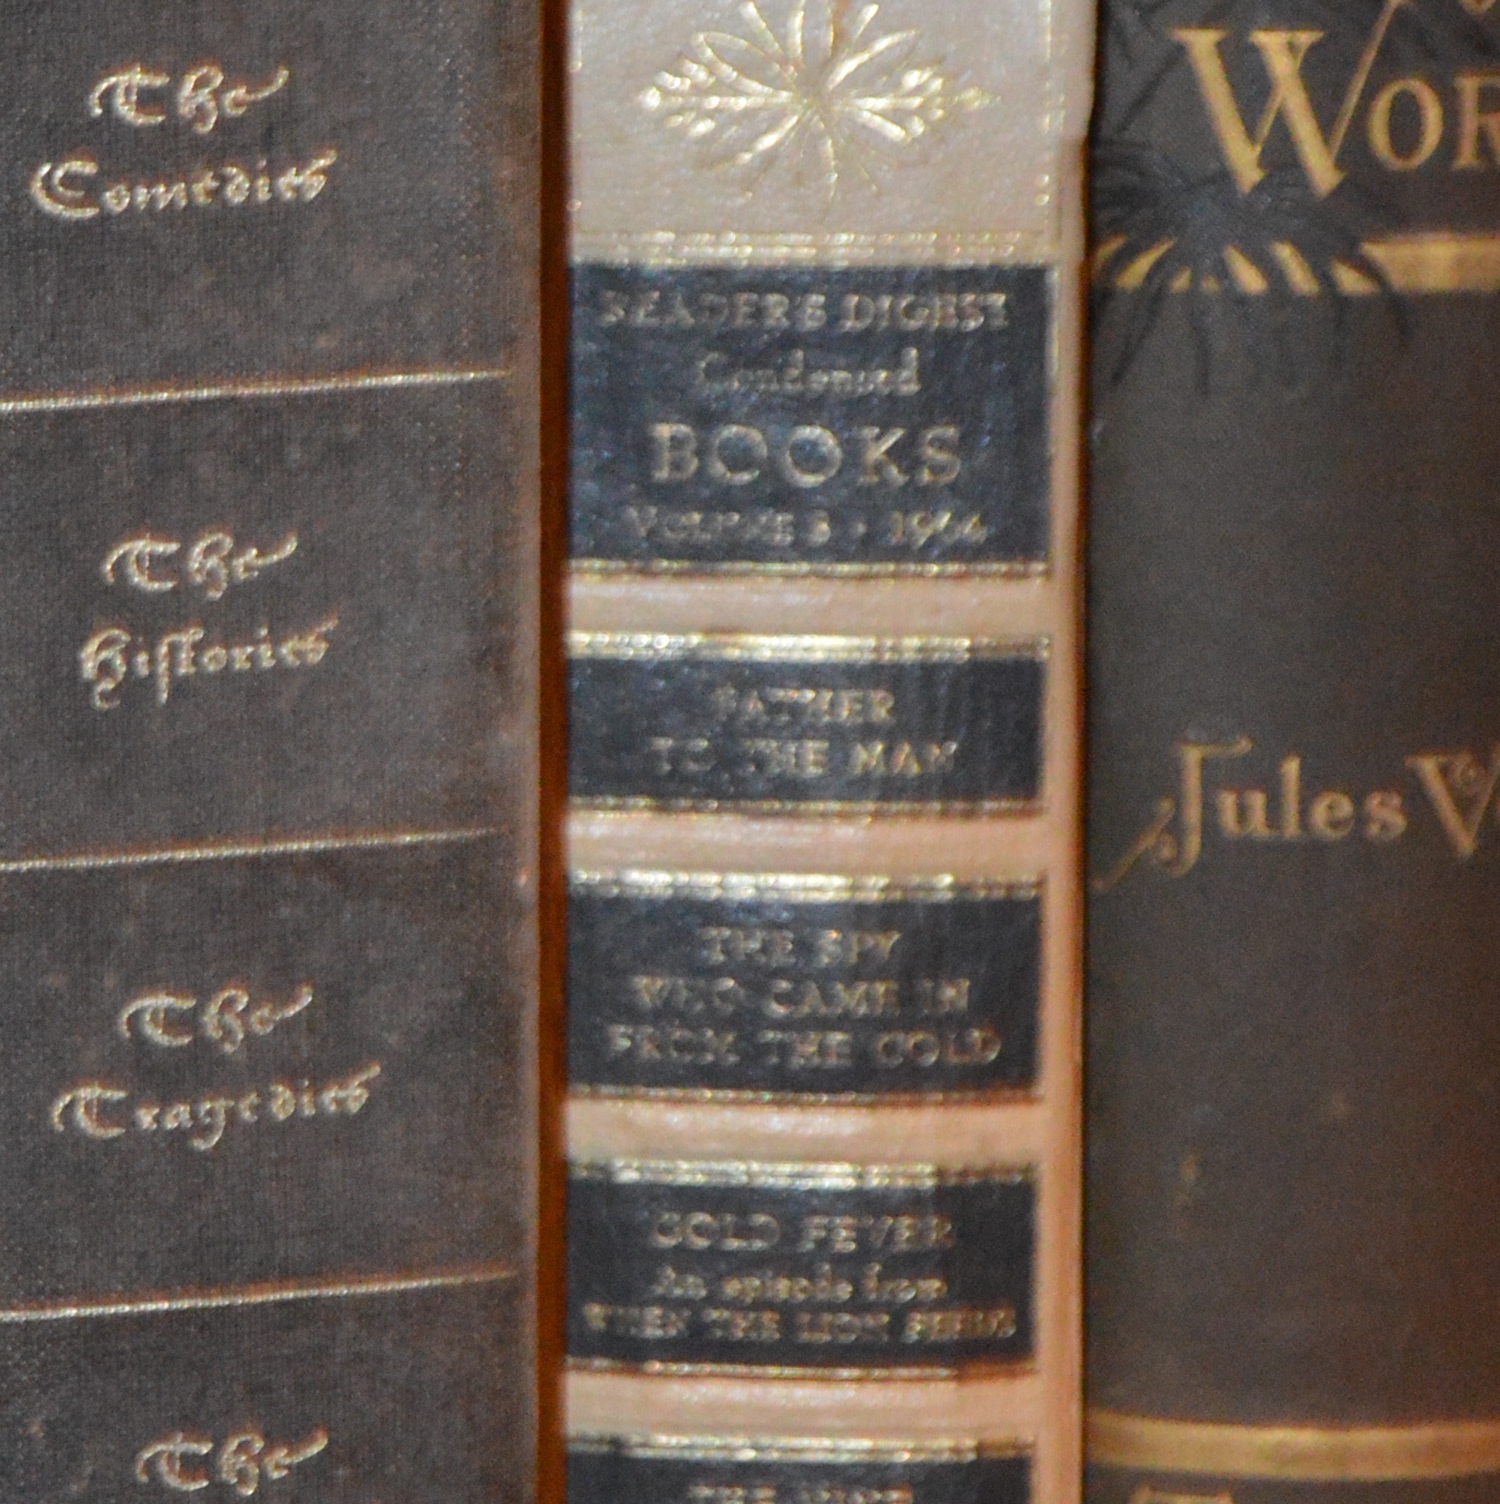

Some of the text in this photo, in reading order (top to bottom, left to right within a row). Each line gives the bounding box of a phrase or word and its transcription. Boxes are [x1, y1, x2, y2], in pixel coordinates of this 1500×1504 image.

[88, 61, 291, 135] The
[648, 422, 964, 490] BOOKS
[103, 532, 299, 600] The
[1092, 734, 1408, 891] Jules
[118, 984, 315, 1054] The
[134, 1426, 330, 1497] The
